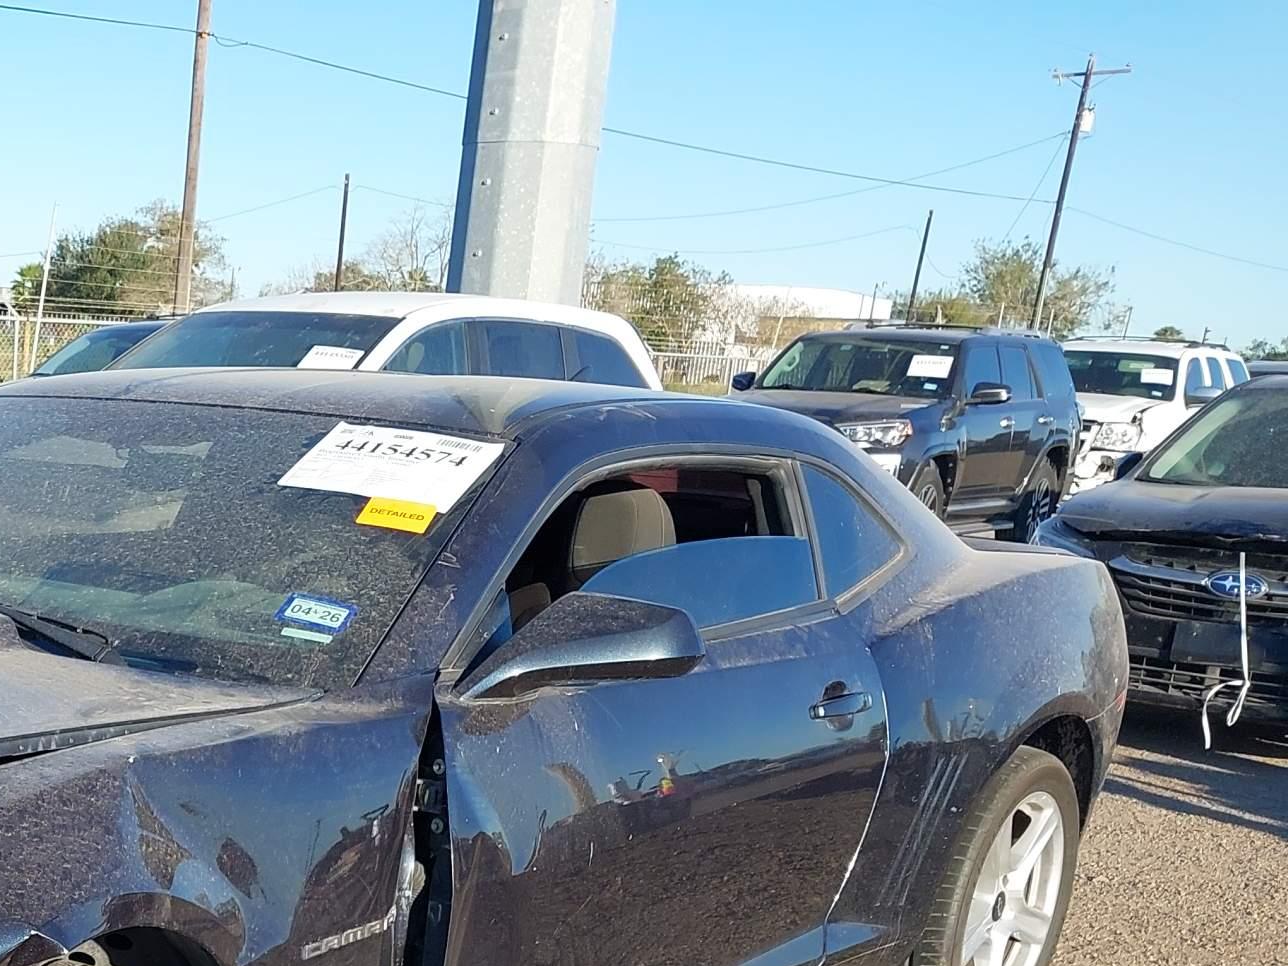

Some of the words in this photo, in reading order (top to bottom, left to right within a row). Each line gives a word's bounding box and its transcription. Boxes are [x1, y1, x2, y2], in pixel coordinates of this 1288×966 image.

[335, 439, 469, 467] 44154574
[369, 506, 425, 521] DETAILED
[291, 604, 312, 616] 04
[318, 609, 343, 623] 26
